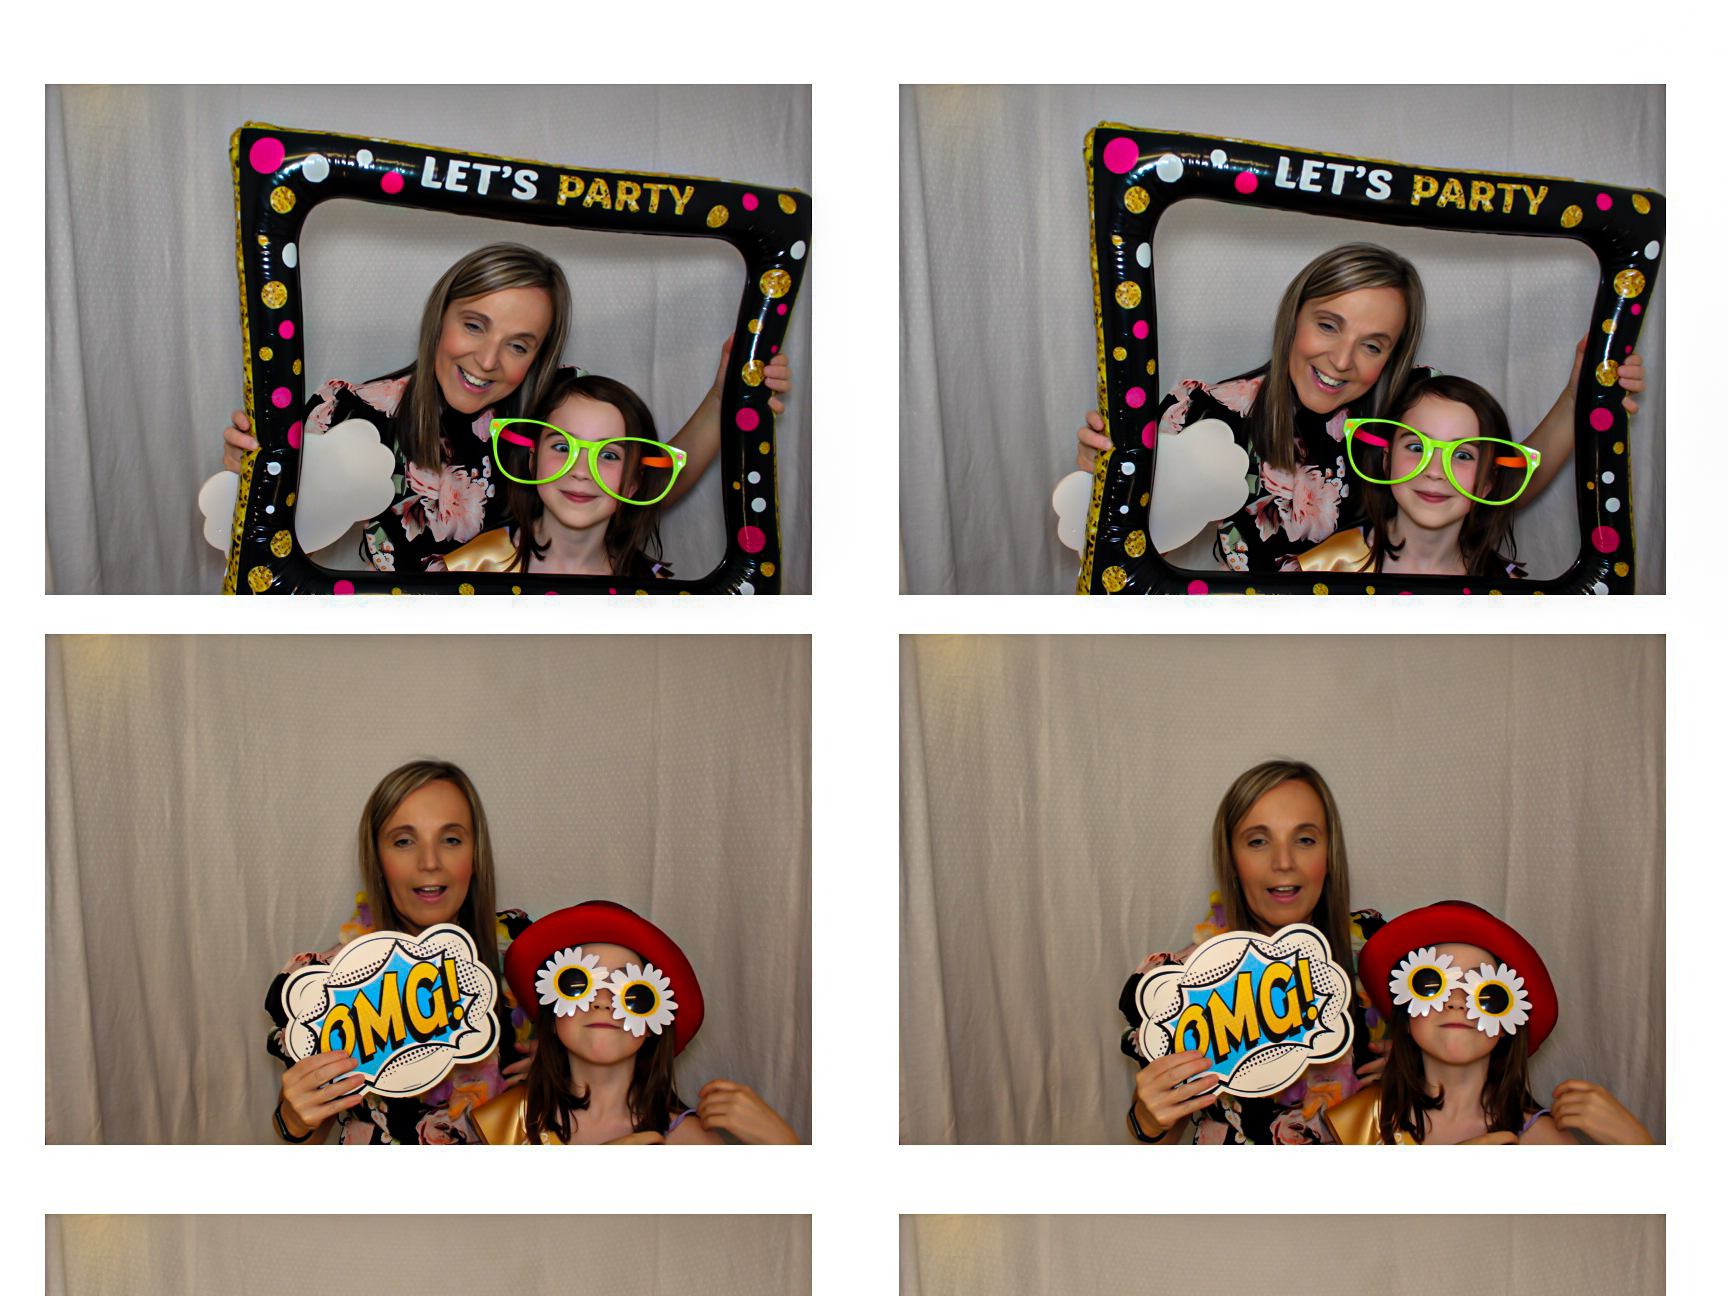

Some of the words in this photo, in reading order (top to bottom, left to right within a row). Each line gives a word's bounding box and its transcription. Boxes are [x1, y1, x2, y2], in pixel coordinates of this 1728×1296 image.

[421, 156, 539, 200] LET'S
[556, 174, 695, 215] PARTY
[1275, 156, 1393, 200] LET'S
[1410, 174, 1549, 215] PARTY
[319, 957, 465, 1064] OMG!
[1173, 957, 1319, 1064] OMG!
